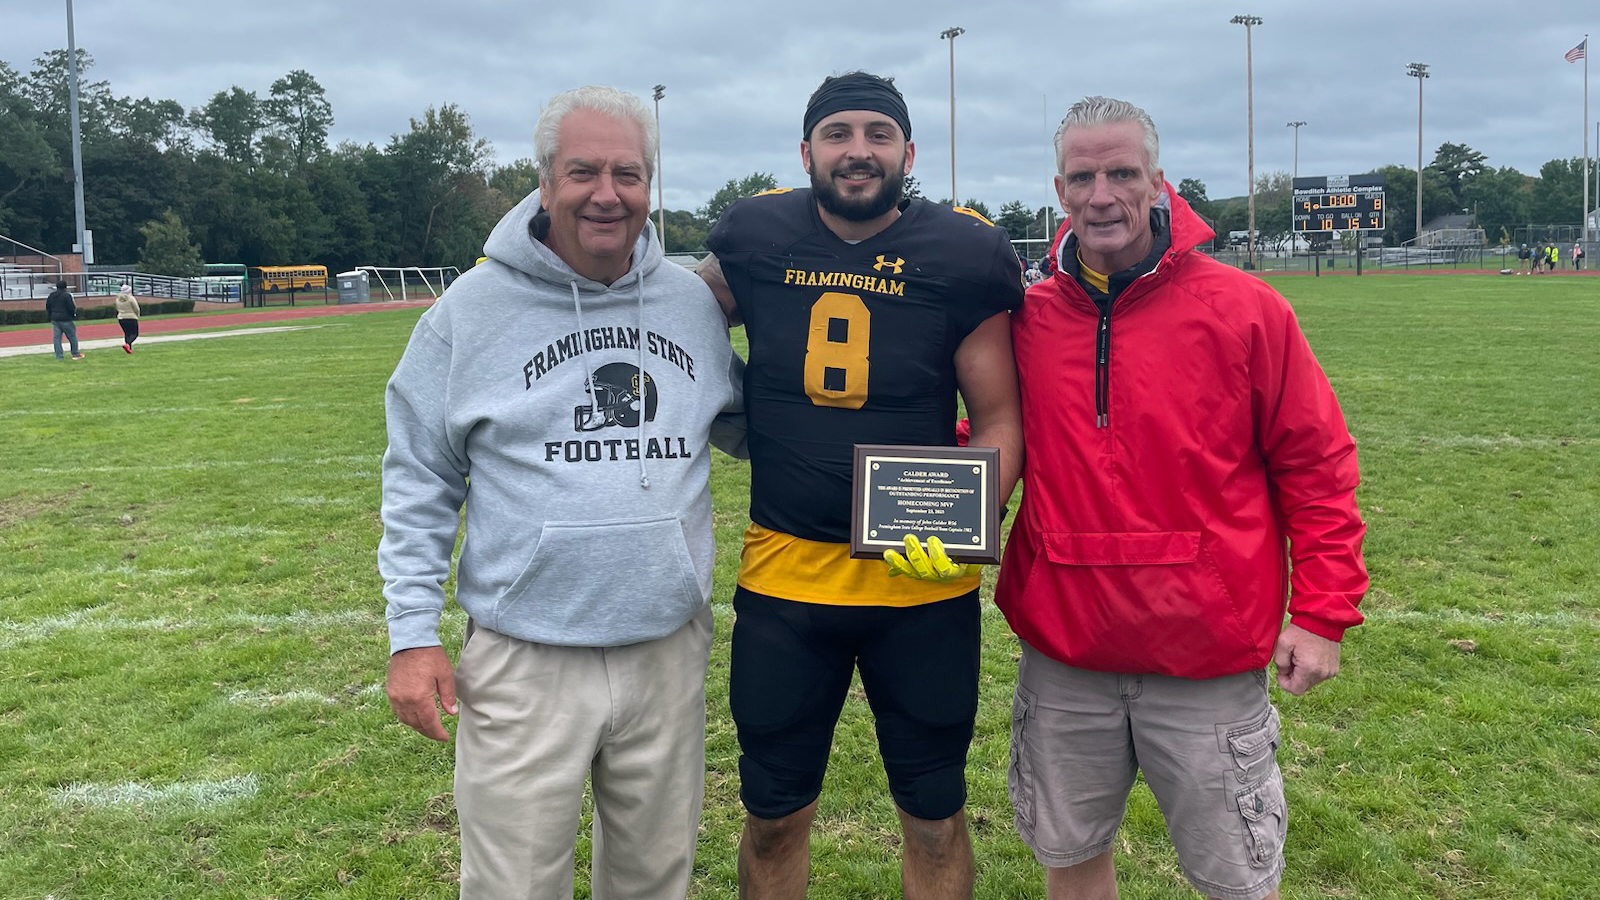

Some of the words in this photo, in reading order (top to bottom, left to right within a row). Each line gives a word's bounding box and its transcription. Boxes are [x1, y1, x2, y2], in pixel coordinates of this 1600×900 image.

[1330, 194, 1355, 206] 0:00
[1374, 199, 1381, 210] 8
[1303, 202, 1310, 212] 9
[1322, 219, 1333, 230] 10
[1348, 218, 1359, 229] 15
[1371, 218, 1378, 228] 4
[784, 269, 905, 296] FRAMINGHAM
[804, 292, 871, 410] 8
[523, 326, 641, 390] FRAMINGHAM
[646, 330, 696, 382] STATE
[544, 437, 691, 462] FOOTBALL
